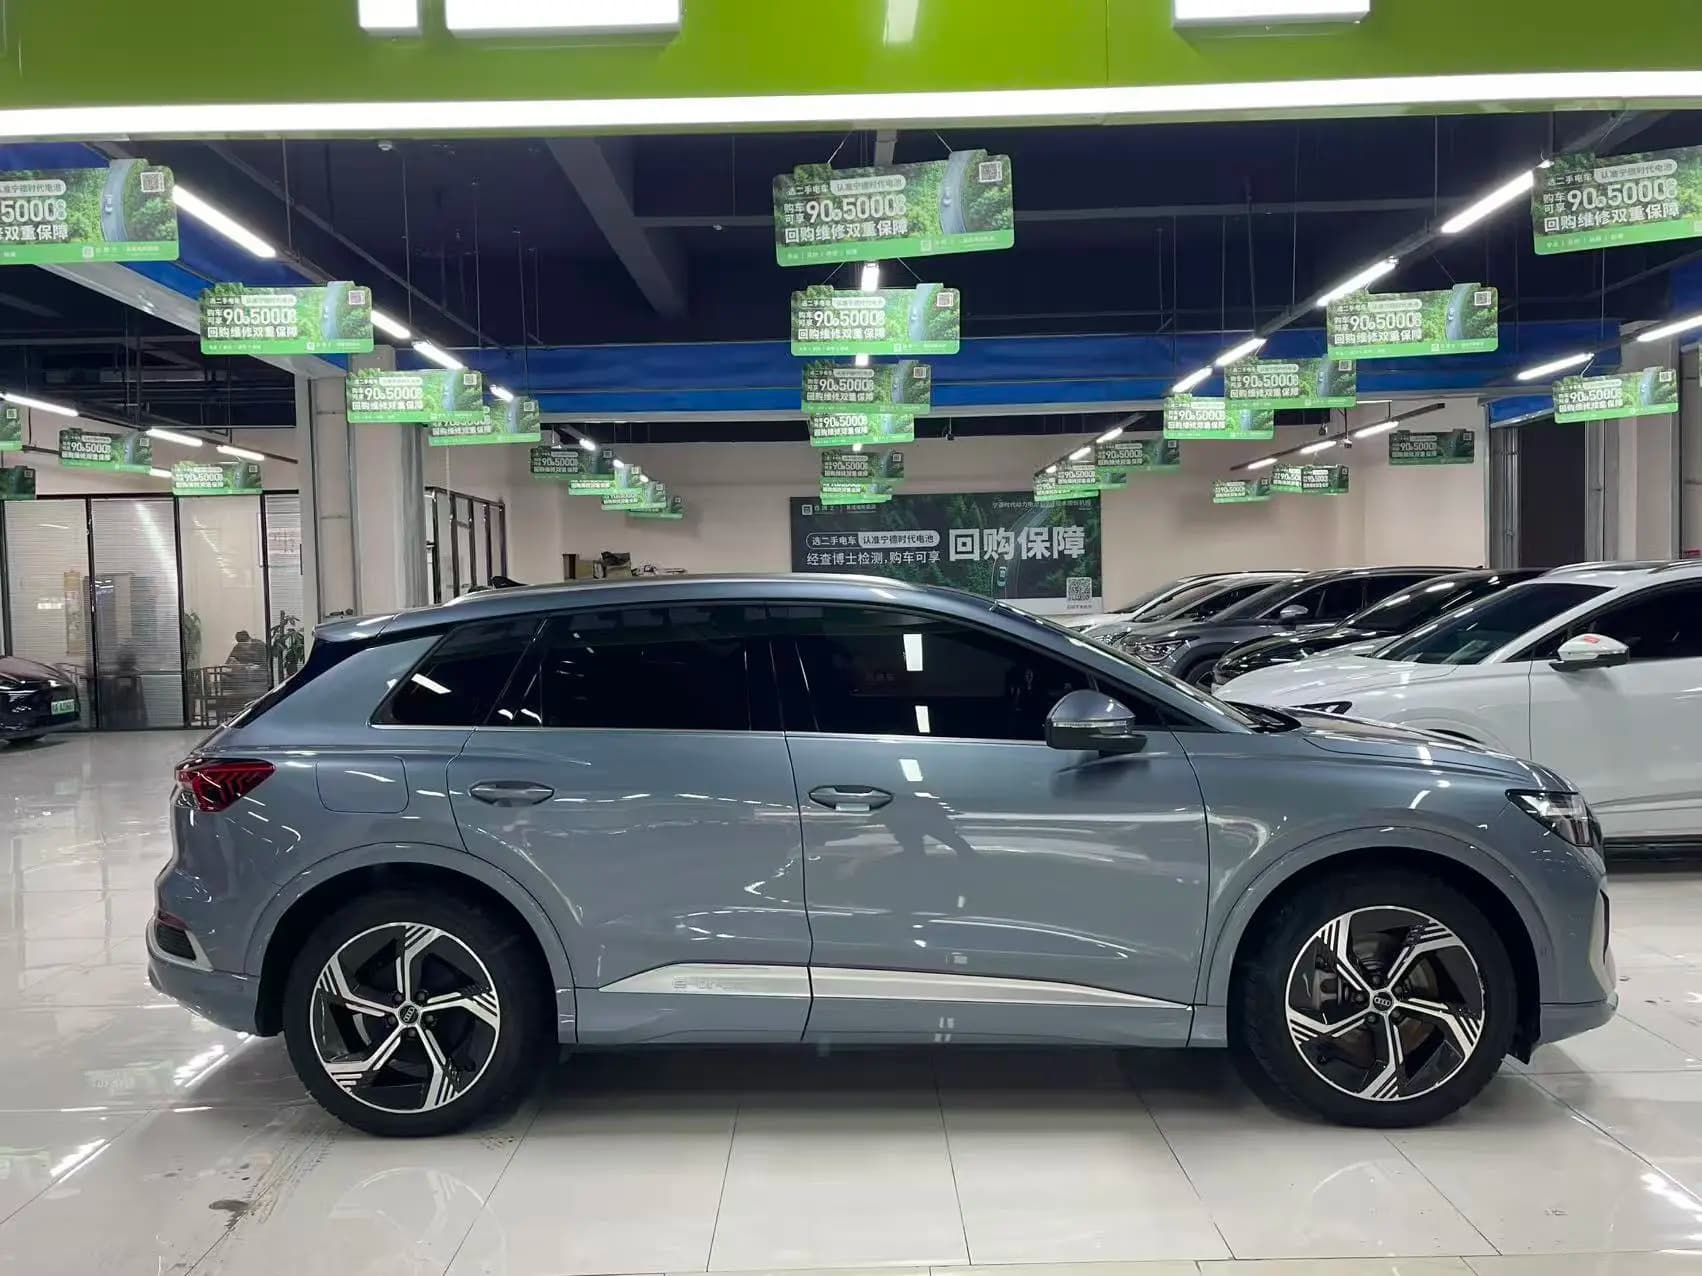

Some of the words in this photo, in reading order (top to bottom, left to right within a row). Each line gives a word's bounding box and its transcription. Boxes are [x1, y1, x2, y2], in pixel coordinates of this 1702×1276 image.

[1543, 202, 1680, 232] 回购维修双重保障
[0, 223, 69, 241] 双重保障
[785, 218, 908, 243] 回购维修双重保障
[812, 535, 857, 546] 选二手电车
[863, 535, 935, 545] 认准宁德时代电池
[949, 525, 1085, 561] 回购保障
